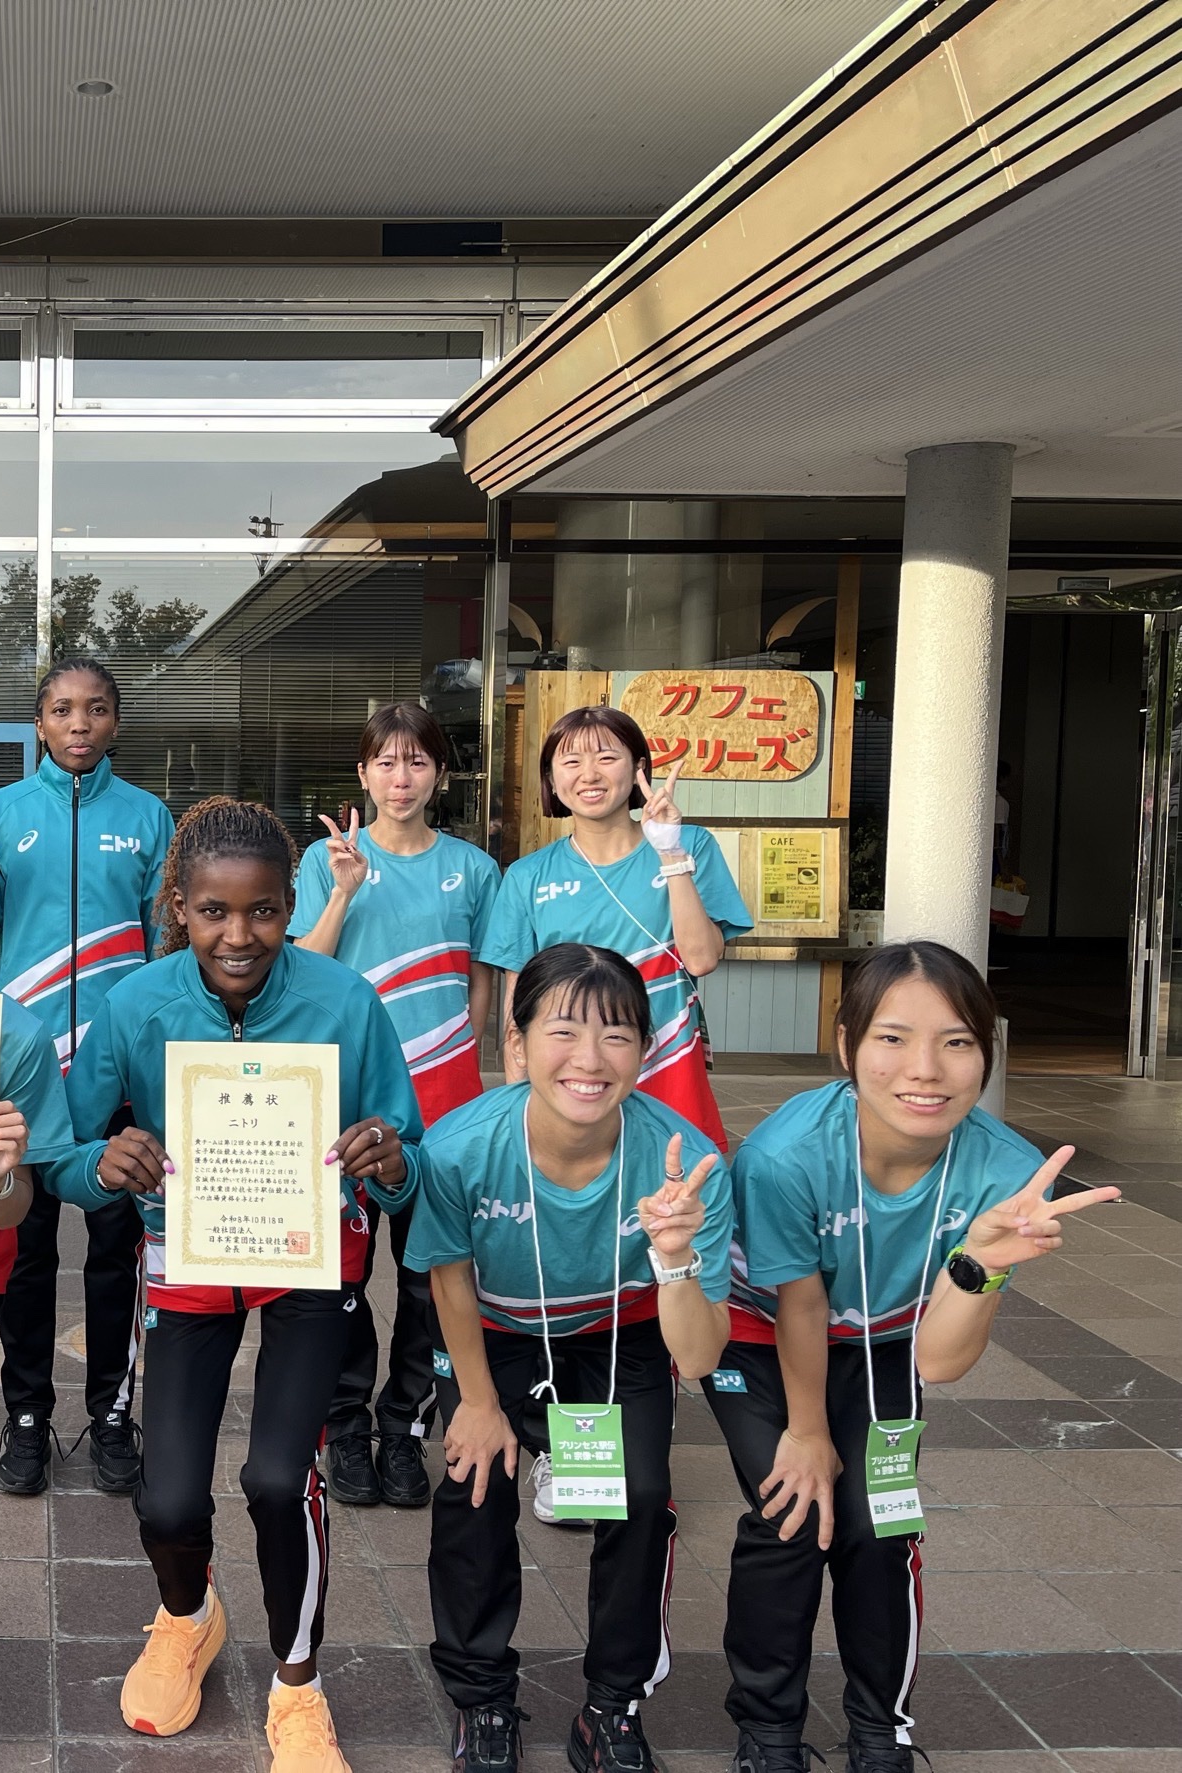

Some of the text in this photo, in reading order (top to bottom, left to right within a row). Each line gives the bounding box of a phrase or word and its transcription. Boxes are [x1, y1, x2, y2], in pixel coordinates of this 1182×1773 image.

[658, 683, 787, 721] カフェ
[648, 727, 811, 773] ツリーズ
[99, 834, 141, 855] ニトリ
[770, 838, 794, 846] CAFE
[536, 880, 581, 904] ニトリ
[218, 1092, 279, 1106] 推薦状
[228, 1118, 258, 1128] ニトリ
[473, 1197, 533, 1225] ニトリ
[204, 1226, 253, 1235] 一般社団法人
[208, 1235, 298, 1246] 日本実業団陸上競技連合
[558, 1440, 617, 1450] プリンセス駅伝
[563, 1452, 572, 1460] in
[871, 1452, 912, 1466] プリンセス駅伝
[874, 1467, 881, 1476] in
